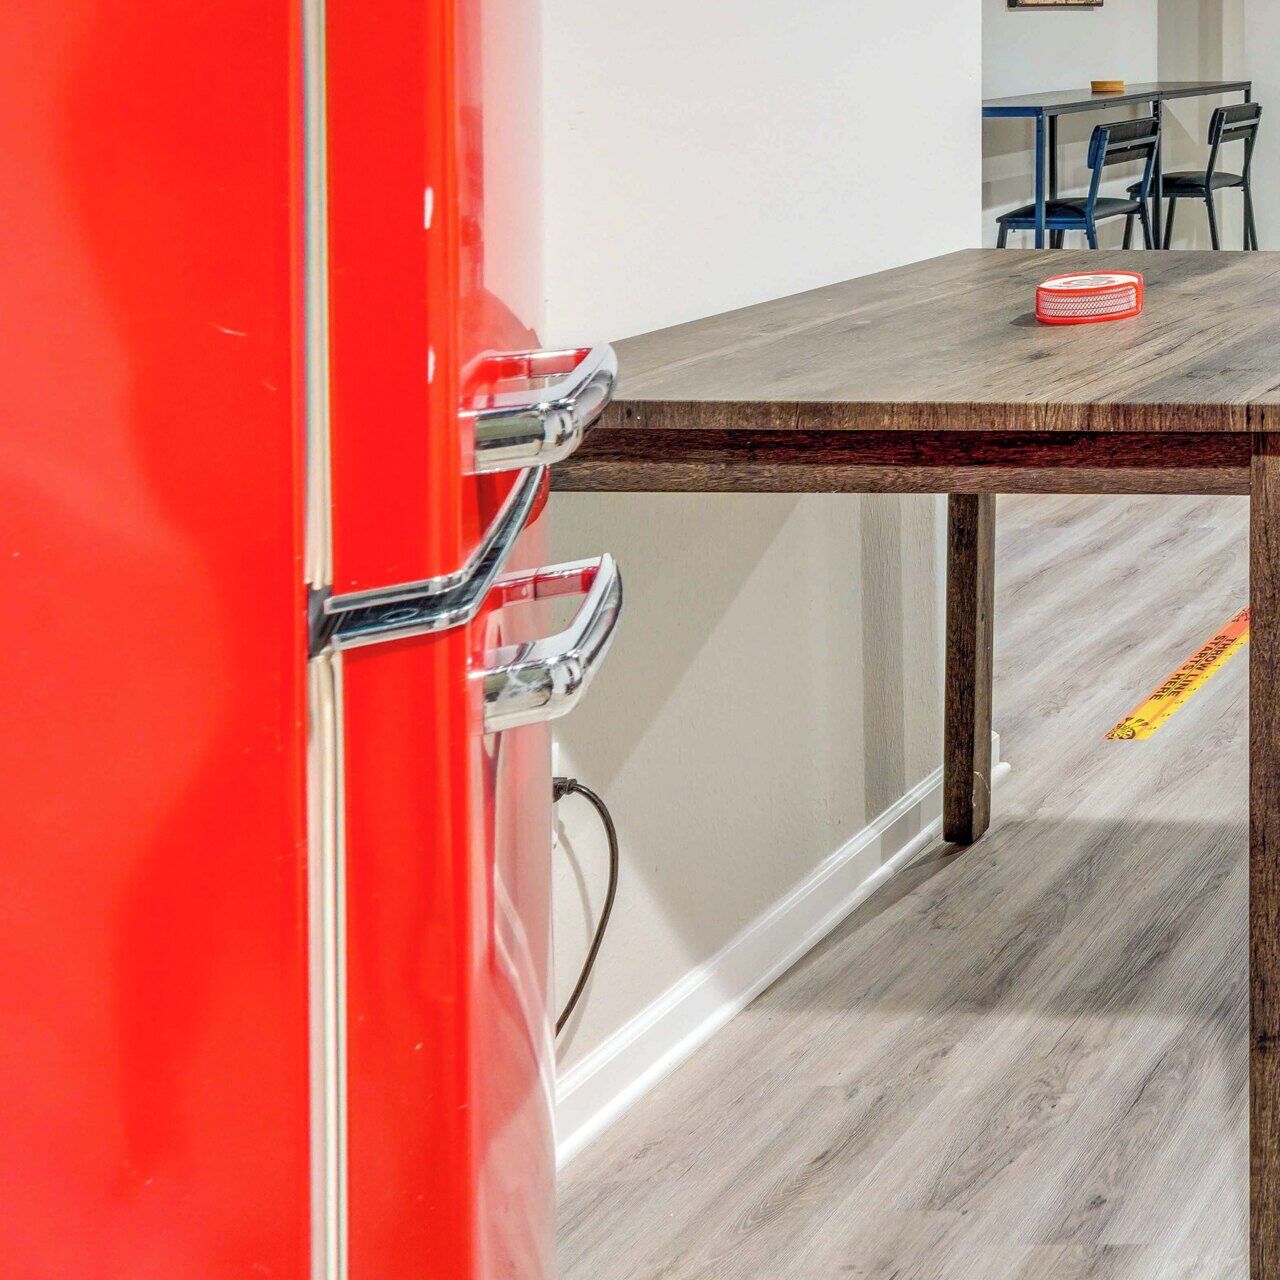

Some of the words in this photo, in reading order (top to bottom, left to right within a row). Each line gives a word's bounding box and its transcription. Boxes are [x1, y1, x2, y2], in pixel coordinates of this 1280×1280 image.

[1183, 634, 1226, 670] STARTS
[1195, 635, 1237, 671] THROW
[1149, 673, 1186, 701] HERE
[1168, 673, 1198, 697] LINE
